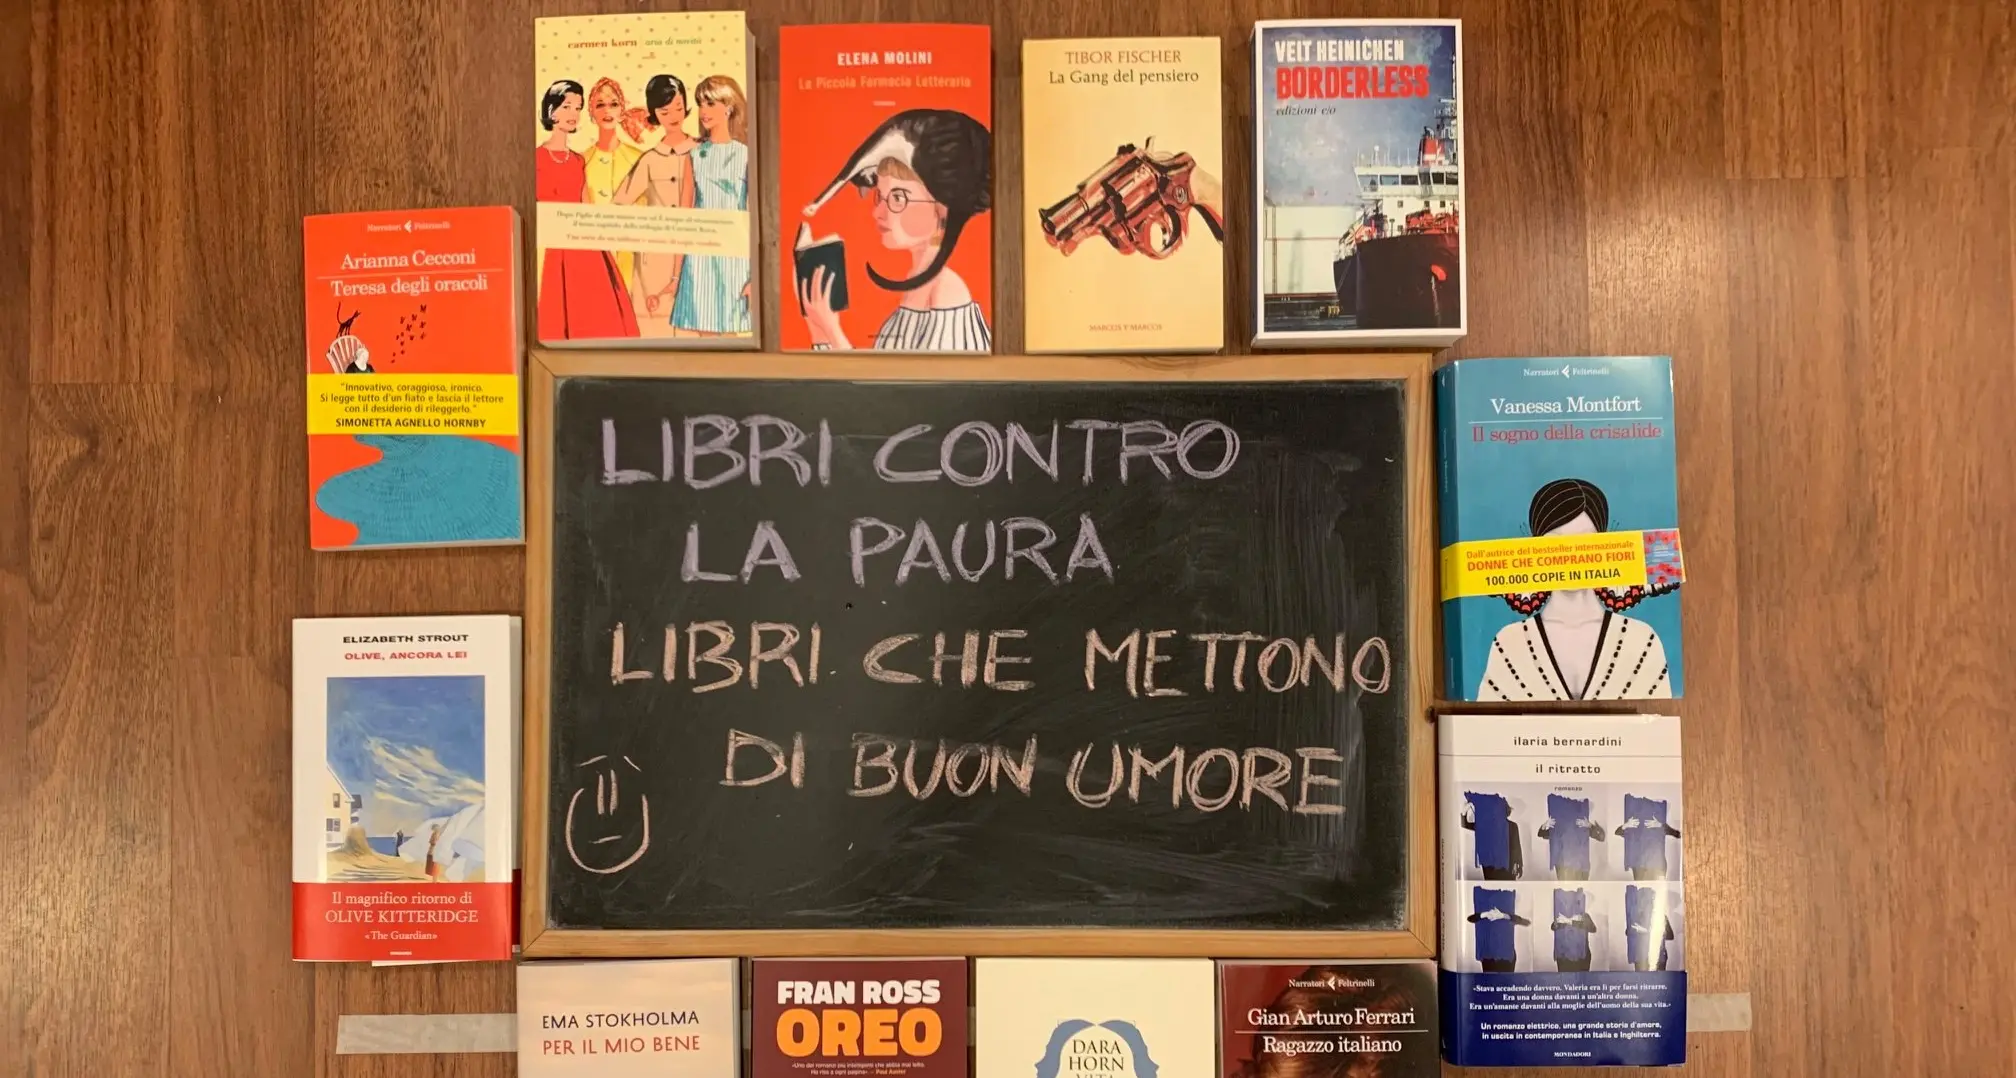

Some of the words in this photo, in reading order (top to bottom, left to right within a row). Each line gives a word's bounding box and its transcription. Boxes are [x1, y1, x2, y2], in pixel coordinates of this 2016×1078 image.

[568, 39, 608, 49] carmen
[611, 38, 638, 47] korn
[1274, 40, 1313, 62] VEIT
[1317, 39, 1405, 62] HEINICHEN
[837, 52, 879, 66] ELENA
[884, 51, 932, 64] MOLINI
[1064, 51, 1113, 64] TIBOR
[1118, 50, 1182, 64] FISCHER
[798, 78, 812, 90] La
[816, 76, 856, 88] Piccola
[860, 75, 911, 88] Farmacia
[916, 75, 972, 88] Letteraria
[1049, 70, 1065, 84] La
[1070, 70, 1108, 86] Gang
[1113, 69, 1134, 83] del
[1139, 70, 1199, 85] pensiero
[1276, 64, 1429, 99] BORDERLESS
[1276, 105, 1317, 116] edizioni
[1321, 107, 1336, 115] e/o
[341, 253, 408, 270] Arianna
[412, 248, 476, 266] Cecconi
[330, 279, 386, 296] Teresa
[390, 276, 430, 296] degli
[434, 274, 488, 291] oracoli
[1523, 368, 1559, 376] Narratori
[320, 394, 328, 403] Si
[331, 394, 355, 404] legge
[358, 394, 379, 403] tutto
[382, 394, 402, 403] d'un
[404, 394, 425, 403] fiato
[436, 394, 461, 403] lascia
[464, 393, 470, 403] il
[472, 394, 504, 404] lettore
[1490, 398, 1562, 415] Vanessa
[1566, 395, 1642, 413] Montfort
[362, 404, 369, 413] il
[371, 404, 411, 413] desiderio
[414, 404, 424, 413] di
[336, 418, 392, 428] SIMONETTA
[395, 419, 441, 428] AGNELLO
[444, 419, 486, 428] HORNBY
[1472, 427, 1484, 442] Il
[1490, 428, 1539, 444] sogno
[1544, 424, 1584, 440] della
[1590, 423, 1662, 439] crisalide
[601, 413, 833, 489] LIBRI
[873, 418, 1241, 486] CONTRO
[680, 520, 801, 584] LA
[848, 511, 1115, 588] PAURA
[1466, 549, 1515, 559] Dall'autrice
[1517, 547, 1531, 556] del
[1532, 544, 1573, 555] bestseller
[1575, 541, 1634, 552] internazionale
[1467, 559, 1508, 572] DONNE
[1512, 557, 1534, 569] CHE
[1536, 554, 1602, 567] COMPRANO
[1606, 550, 1635, 562] FIORI
[1485, 574, 1529, 586] 100.000
[1532, 571, 1565, 583] COPIE
[1569, 571, 1581, 581] IN
[1584, 568, 1621, 580] ITALIA
[343, 636, 413, 644] ELIZABETH
[344, 652, 385, 661] OLIVE,
[390, 651, 443, 660] ANCORA
[448, 651, 467, 659] LEI
[611, 620, 822, 694] LIBRI
[863, 628, 1036, 692] CHE
[1084, 628, 1392, 698] METTONO
[1514, 736, 1548, 746] ilaria
[1553, 737, 1622, 747] bernardini
[718, 728, 806, 789] DI
[846, 732, 1038, 800] BUON
[1066, 740, 1347, 815] UMORE
[1535, 764, 1543, 774] il
[1548, 764, 1601, 774] ritratto
[332, 892, 342, 904] Il
[346, 892, 408, 908] magnifico
[411, 892, 456, 904] ritorno
[459, 892, 472, 904] di
[325, 910, 373, 923] OLIVE
[379, 910, 479, 923] KITTERIDGE
[1289, 979, 1325, 988] Narratori
[1338, 979, 1375, 988] Feltrinelli
[1496, 984, 1532, 992] accadendo
[1533, 984, 1562, 992] davvero.
[1564, 983, 1588, 992] Valeria
[1609, 984, 1621, 993] per
[1623, 983, 1638, 991] farsi
[778, 980, 856, 1004] FRAN
[862, 979, 941, 1004] ROSS
[1562, 1002, 1585, 1011] moglie
[542, 1015, 579, 1029] EMA
[586, 1011, 699, 1028] STOKHOLMA
[1247, 1009, 1291, 1026] Gian
[1293, 1009, 1353, 1026] Arturo
[1354, 1008, 1416, 1025] Ferrari
[777, 1007, 943, 1057] OREO
[1481, 1022, 1492, 1031] Un
[1578, 1022, 1604, 1031] grande
[1524, 1032, 1582, 1040] contemporanea
[543, 1039, 575, 1055] PER
[582, 1039, 597, 1054] IL
[605, 1038, 645, 1054] MIO
[653, 1036, 700, 1052] BENE
[1073, 1040, 1121, 1055] DARA
[1263, 1036, 1334, 1056] Ragazzo
[1338, 1036, 1402, 1053] italiano
[1069, 1056, 1124, 1071] HORN
